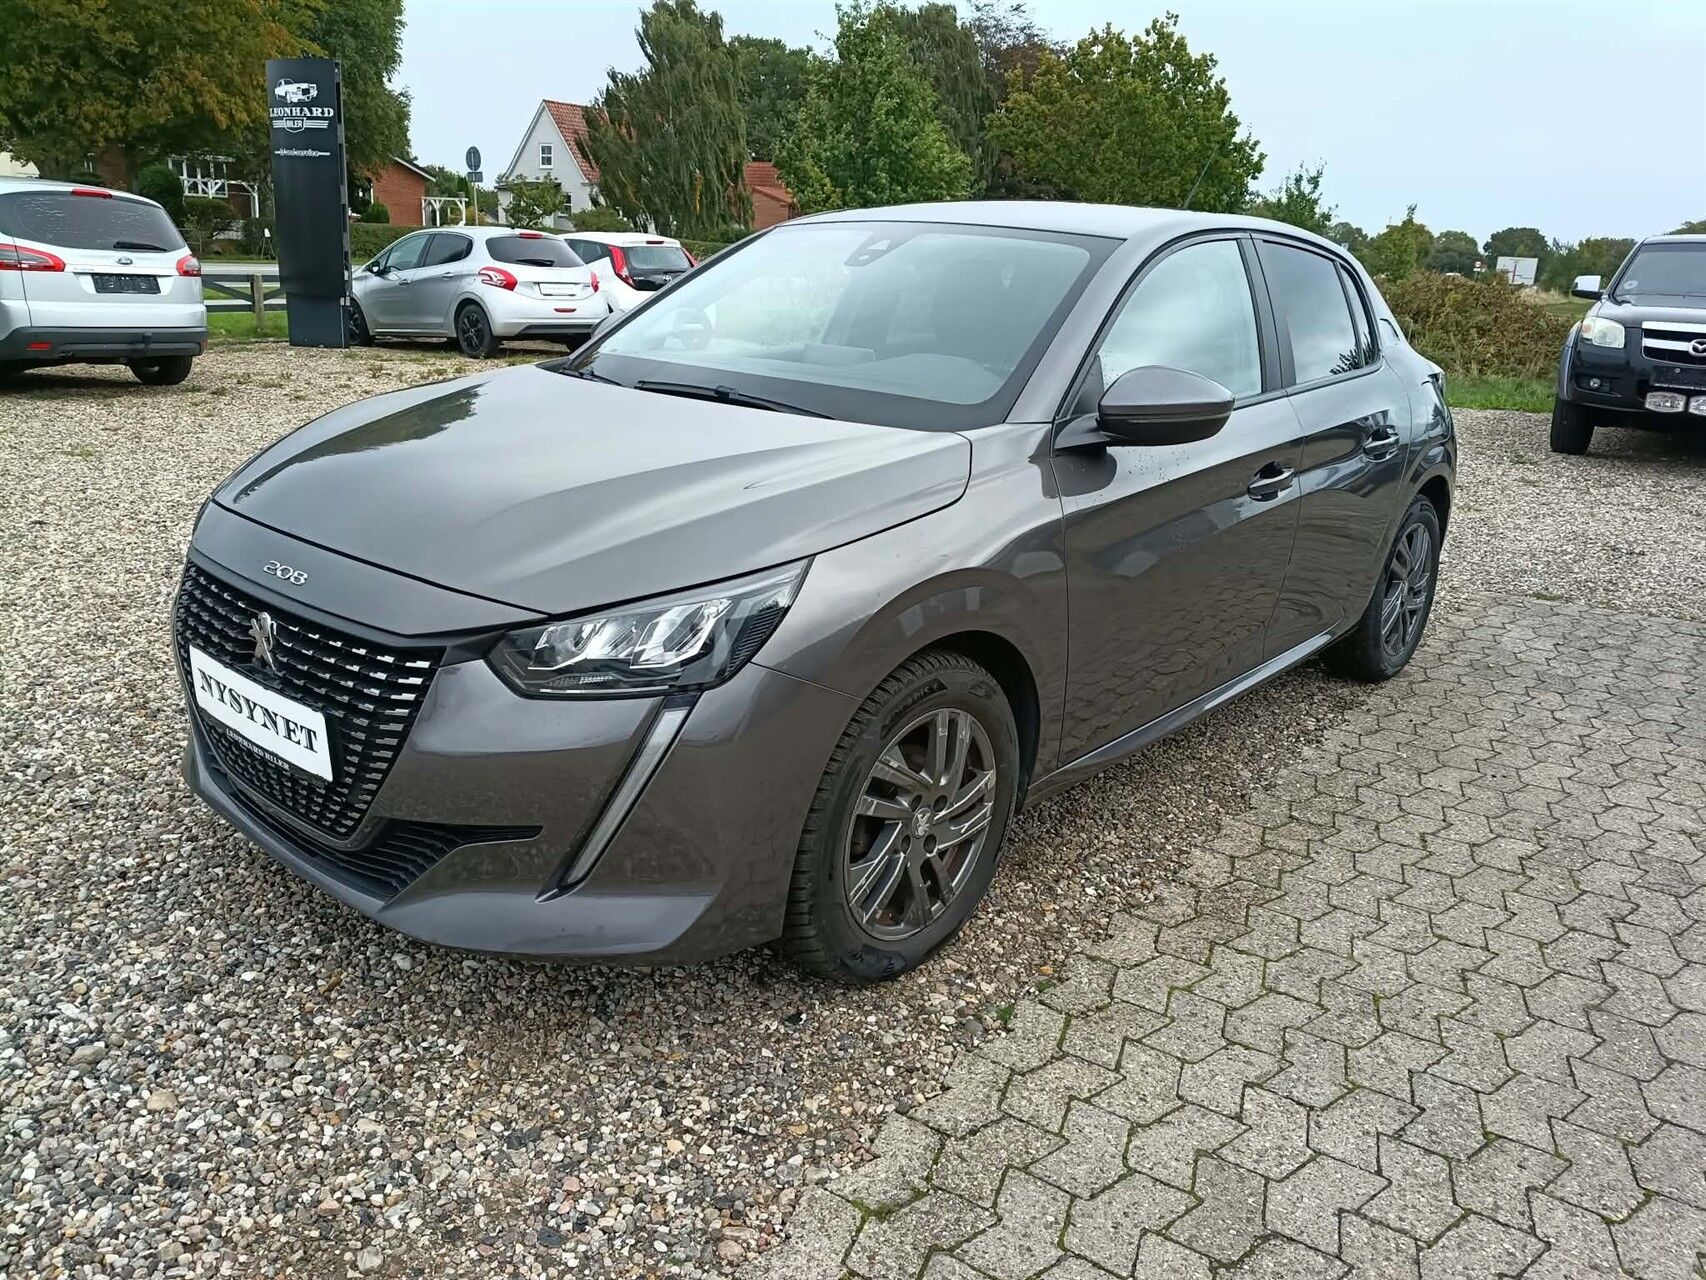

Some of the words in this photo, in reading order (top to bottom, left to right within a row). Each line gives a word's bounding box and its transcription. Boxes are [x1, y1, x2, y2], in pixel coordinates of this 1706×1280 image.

[269, 107, 334, 117] LEONHARD
[263, 560, 308, 585] 208
[197, 667, 318, 753] NYSYNET
